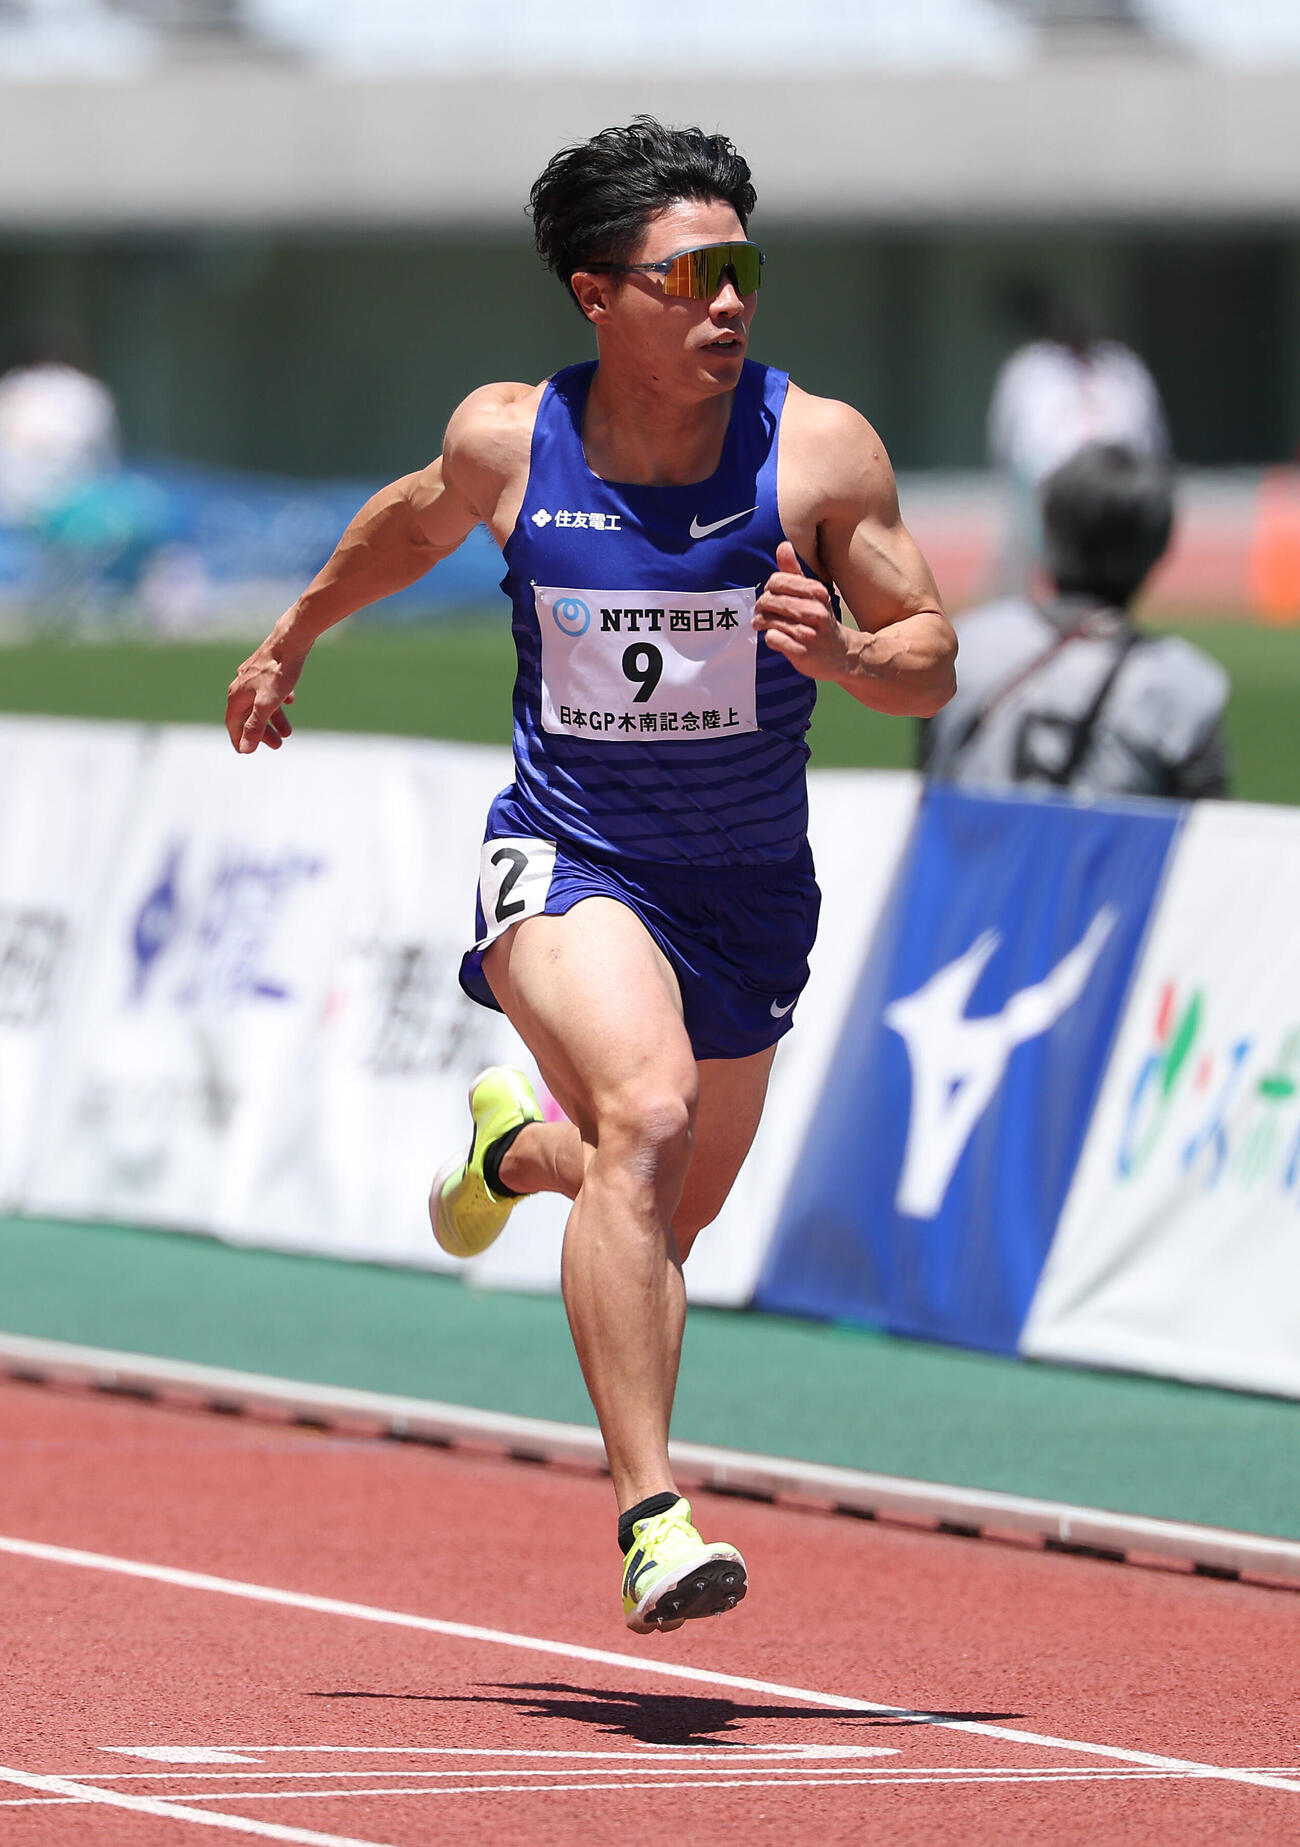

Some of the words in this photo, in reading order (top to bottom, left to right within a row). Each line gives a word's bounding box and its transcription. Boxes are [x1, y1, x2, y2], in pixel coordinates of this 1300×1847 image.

[555, 509, 621, 531] 住友電工
[622, 642, 663, 702] 9
[560, 706, 740, 732] 日本GP木南記念陸上
[491, 847, 529, 923] 2
